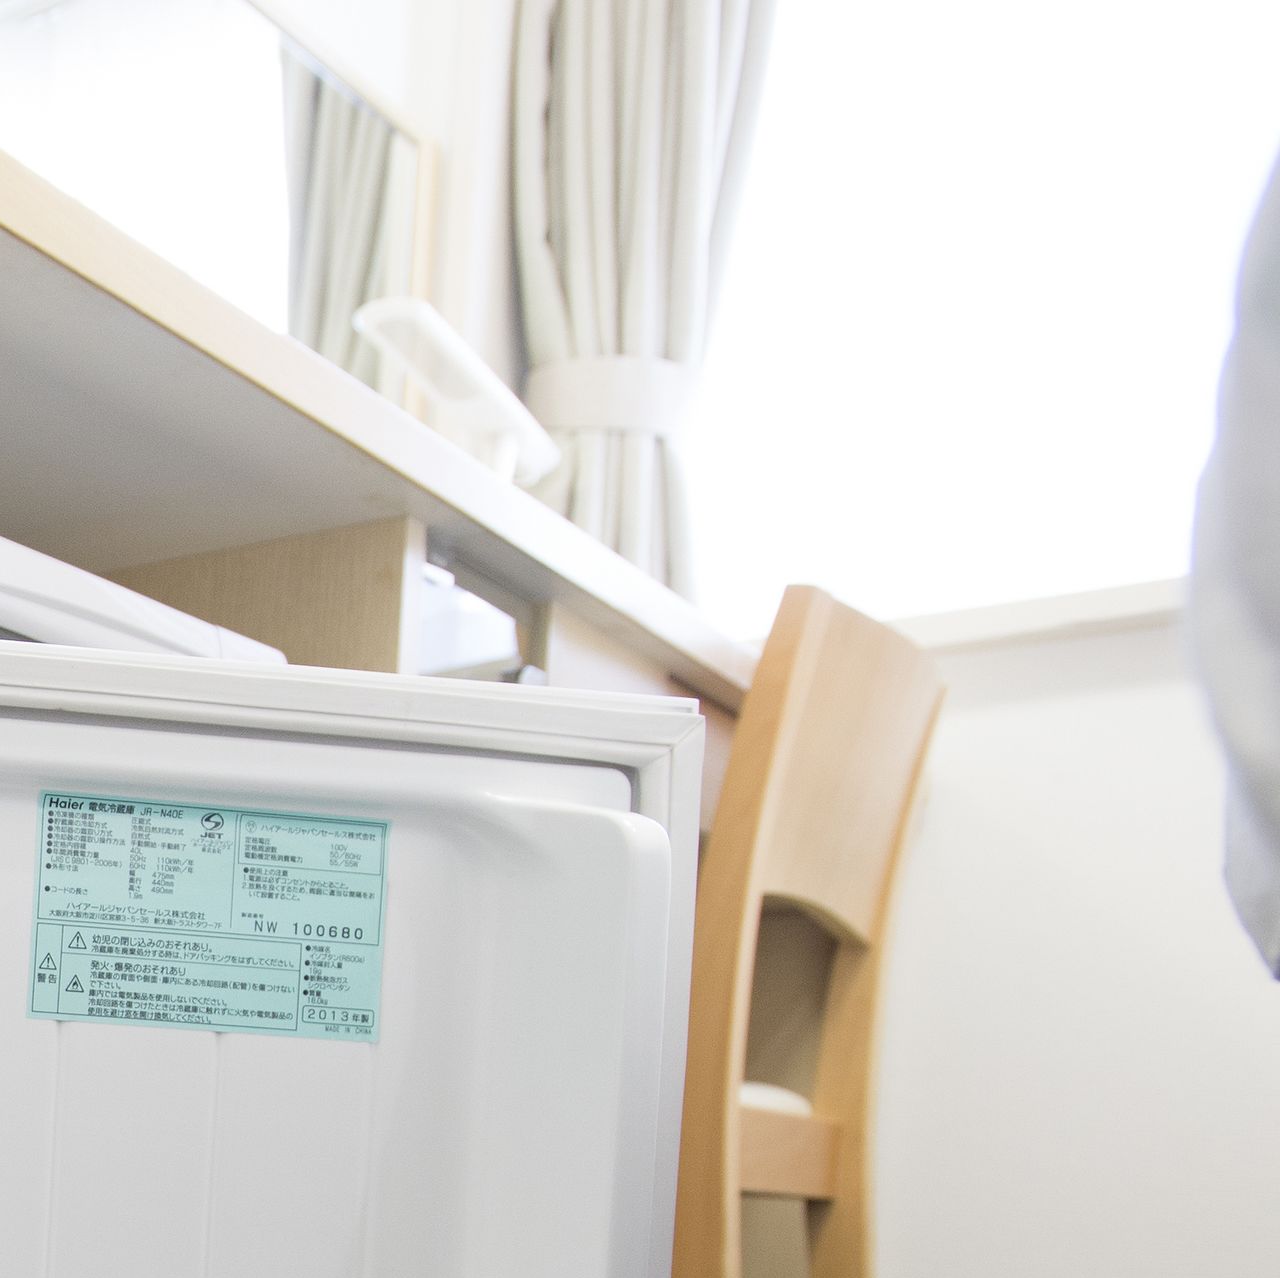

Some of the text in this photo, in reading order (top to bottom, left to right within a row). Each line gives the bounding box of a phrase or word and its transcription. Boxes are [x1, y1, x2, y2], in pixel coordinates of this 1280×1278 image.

[49, 797, 84, 810] Haier
[89, 801, 135, 815] 電気冷蔵庫
[200, 832, 224, 840] JET
[66, 902, 206, 921] ハイアールジャパンセールス株式会社
[254, 919, 364, 940] NW 100680
[92, 934, 212, 953] 幼児の閉じ込みのおそれあり。
[37, 972, 57, 984] 警告
[89, 980, 121, 990] で下さい。
[308, 1008, 370, 1024] 2013年製
